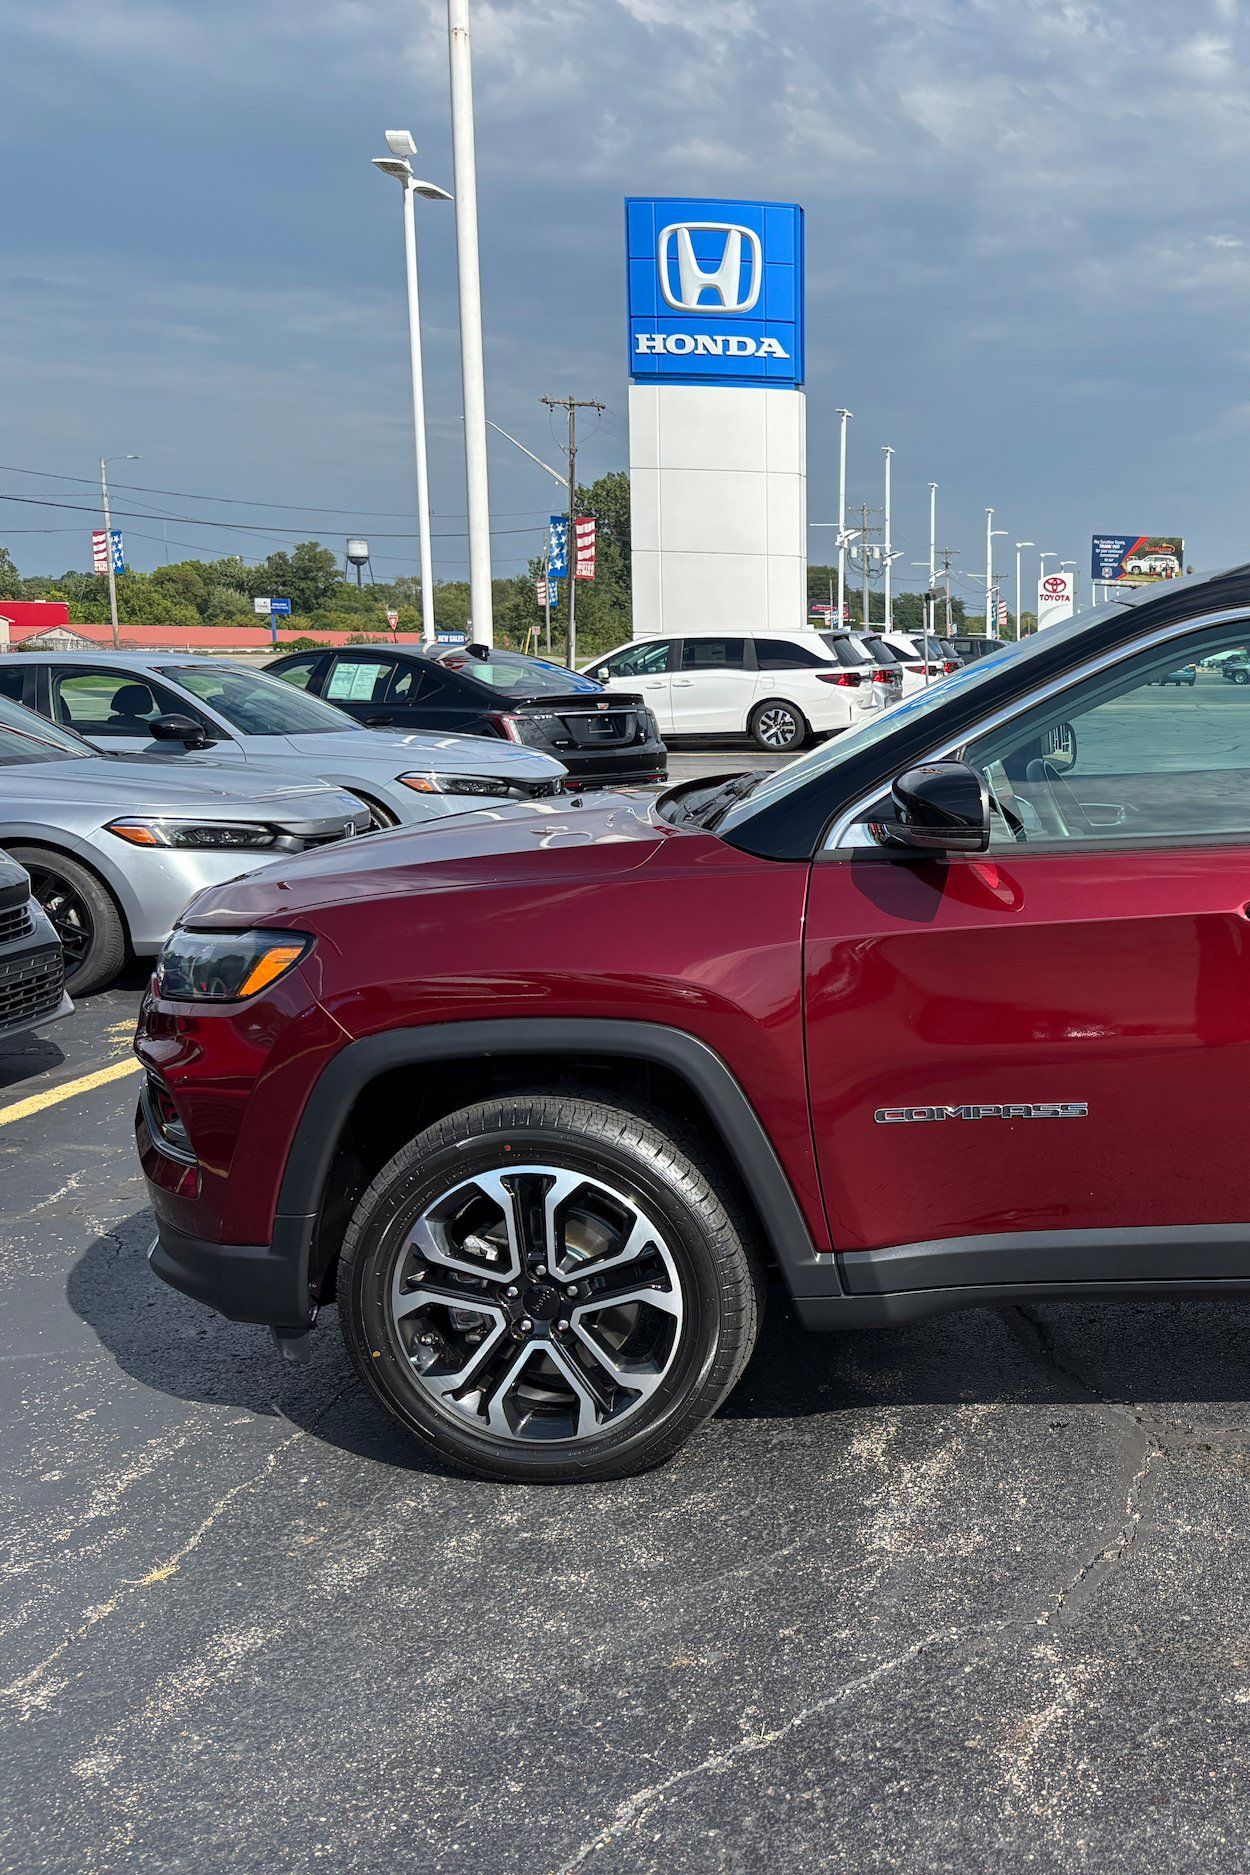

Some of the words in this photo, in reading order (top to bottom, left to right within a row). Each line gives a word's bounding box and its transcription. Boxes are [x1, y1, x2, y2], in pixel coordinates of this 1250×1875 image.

[634, 333, 790, 358] HONDA
[1039, 594, 1071, 602] TOYOTA
[449, 634, 464, 643] SALES
[873, 1102, 1089, 1124] COMPASS
